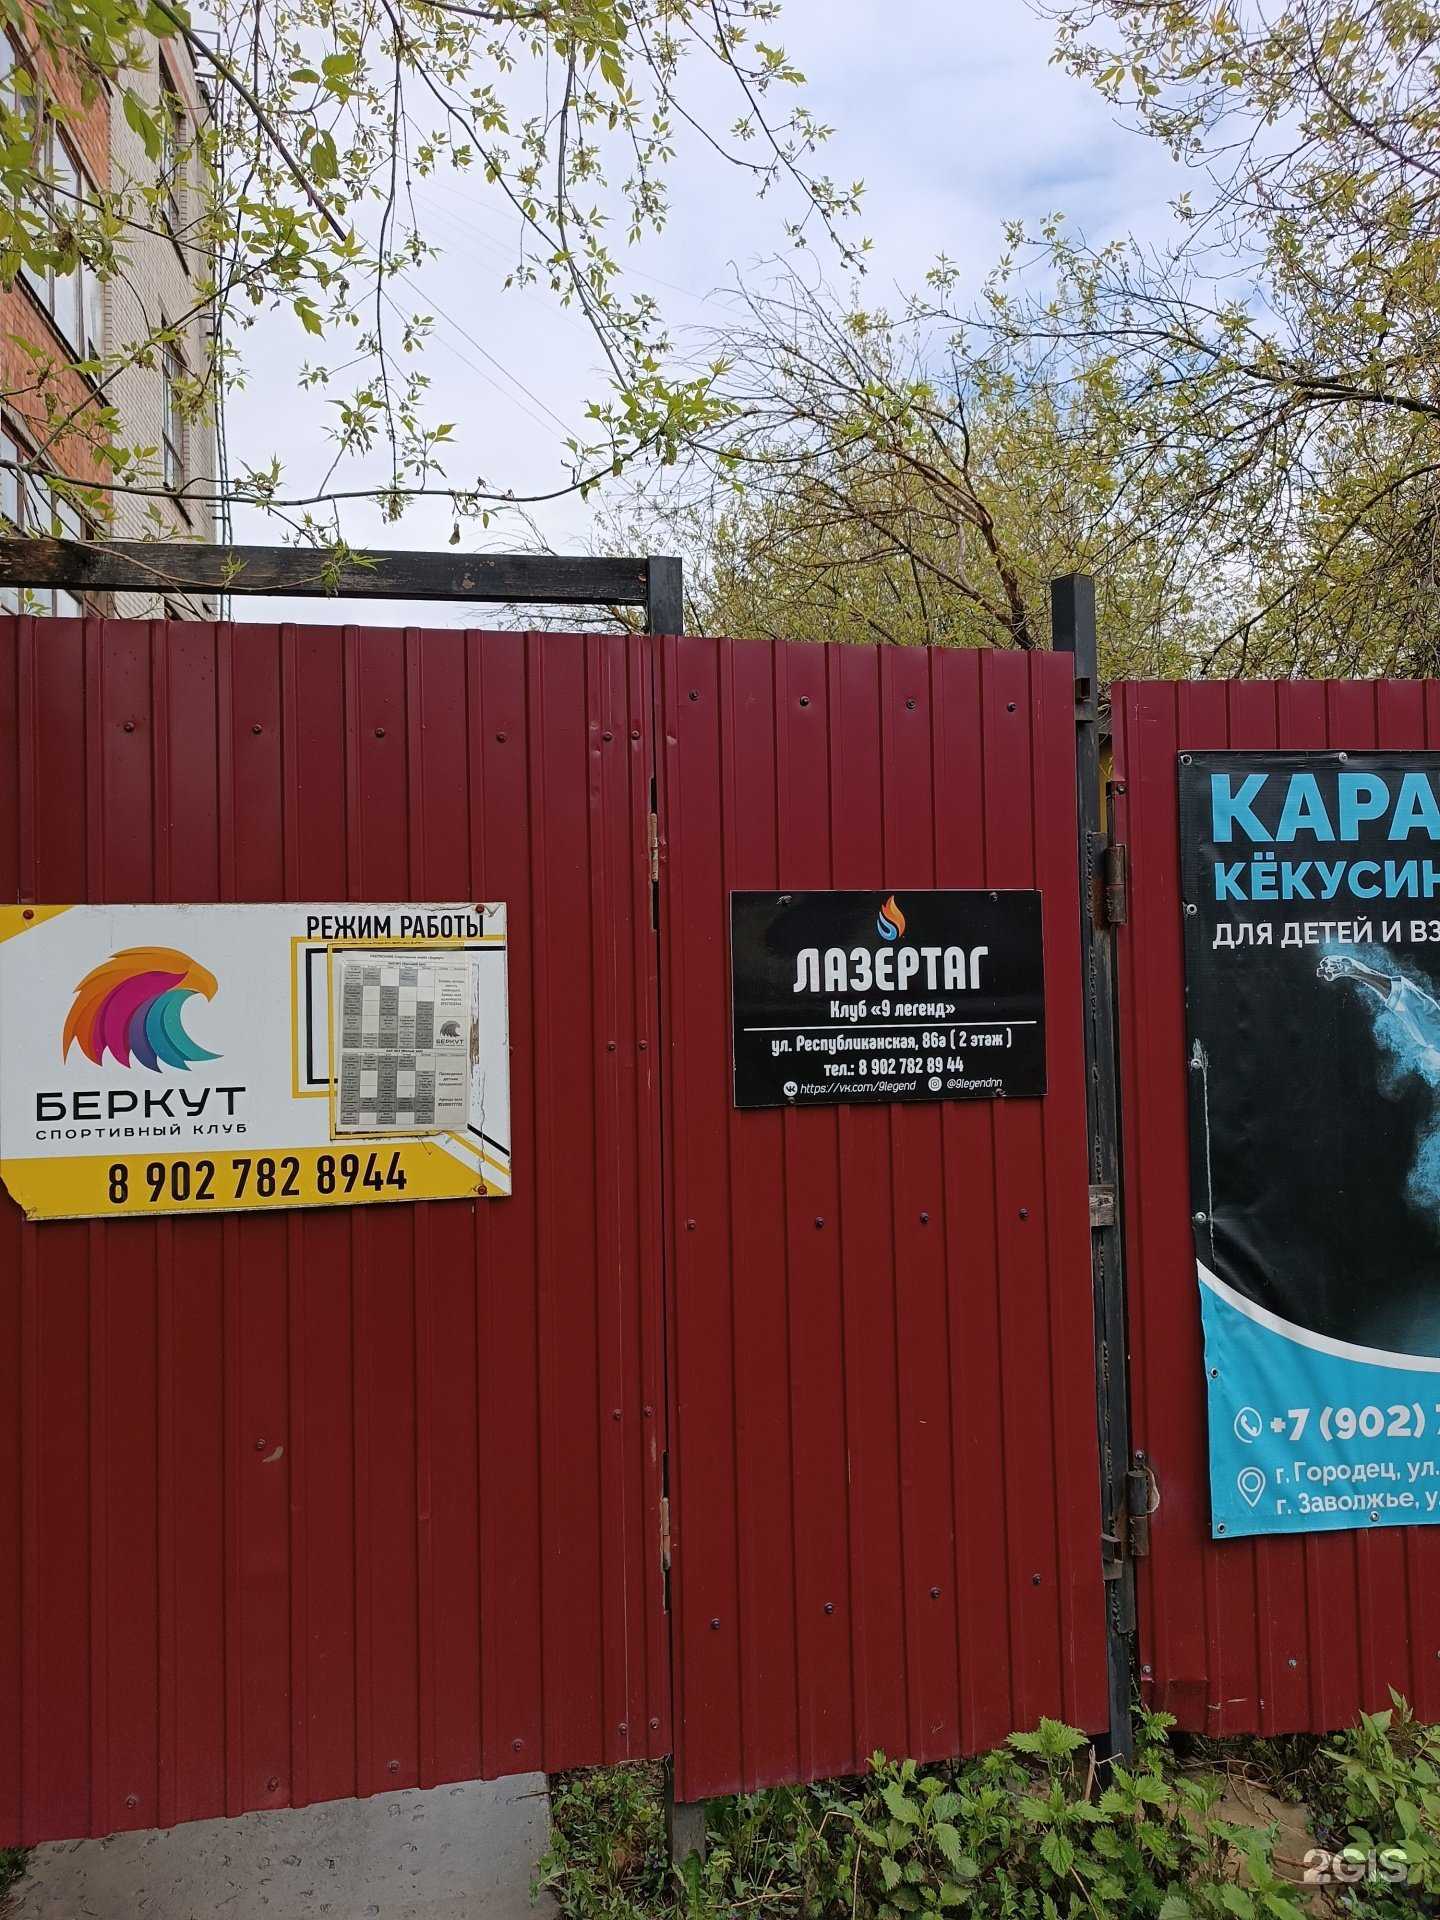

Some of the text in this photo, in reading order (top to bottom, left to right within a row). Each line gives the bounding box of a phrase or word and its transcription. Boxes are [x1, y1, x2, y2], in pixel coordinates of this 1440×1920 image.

[306, 914, 485, 940] РЕЖИМ РАБОТЫ
[1212, 922, 1273, 950] ДЛЯ
[1280, 916, 1373, 949] ДЕТЕЙ
[1382, 920, 1402, 944] И
[793, 946, 988, 993] ЛАЗЕРТАГ
[830, 999, 956, 1022] Клуб «9 легенд»
[771, 1037, 793, 1057] ул.
[796, 1033, 918, 1056] Республиканская,
[922, 1032, 946, 1049] 86а
[971, 1030, 1003, 1048] этаж
[824, 1057, 964, 1077] тел.: 8 902 782 89 44
[800, 1080, 917, 1096] https://vk.com/9legend
[36, 1086, 247, 1123] БЕРКУТ
[35, 1122, 247, 1141] СПОРТИВНЫЙ КЛУБ
[108, 1151, 407, 1205] 8 902 782 8944
[1270, 1408, 1310, 1441] +7
[1320, 1403, 1425, 1442] (902)
[1276, 1461, 1440, 1486] г. Городец, ул.
[1276, 1491, 1440, 1515] г. Заволжье, у
